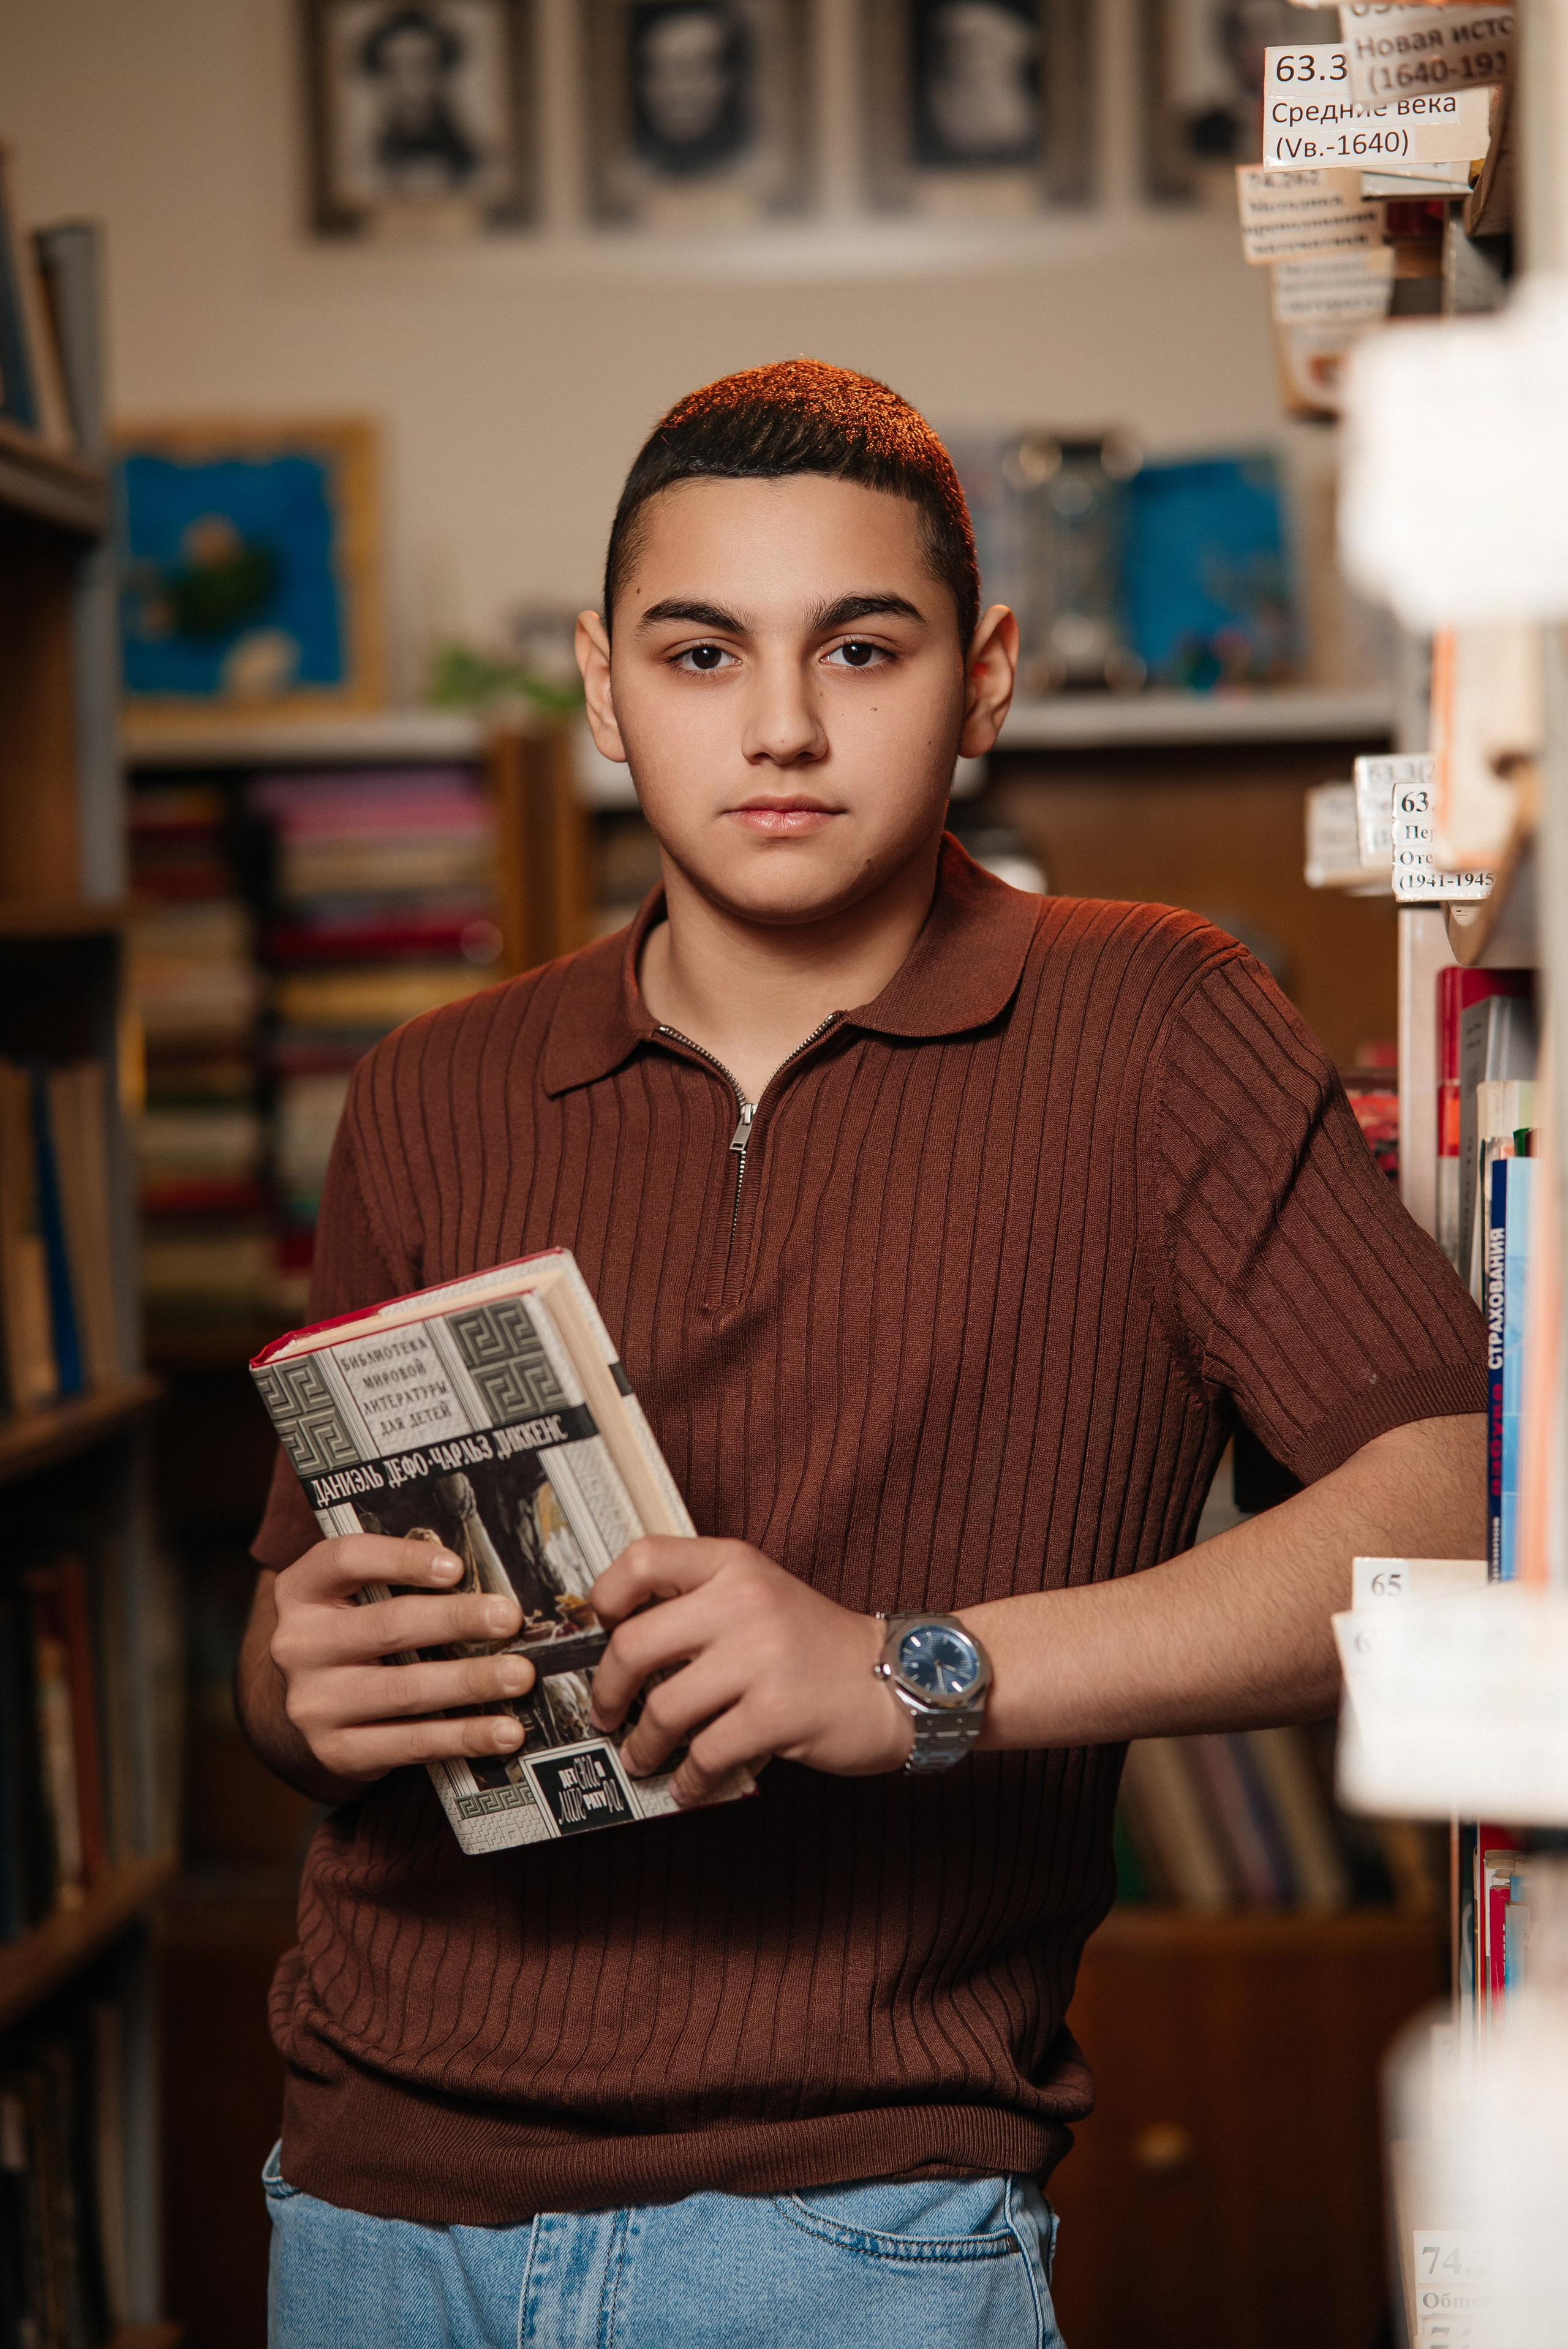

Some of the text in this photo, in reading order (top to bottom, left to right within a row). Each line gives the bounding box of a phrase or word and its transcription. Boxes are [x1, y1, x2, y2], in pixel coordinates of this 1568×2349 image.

[1355, 28, 1444, 60] Новая
[1276, 54, 1348, 81] 63.3
[1397, 95, 1457, 115] века
[1276, 129, 1409, 160] (Vв.-1640)
[1400, 872, 1494, 892] (1941-1945
[1488, 1227, 1505, 1370] СТРАХОВАНИЯ
[341, 1337, 428, 1371] БИБЛИОТЕКА
[363, 1358, 427, 1389] МИРОВОЙ
[363, 1380, 449, 1416] ЛИТЕРАТУРЫ
[380, 1401, 452, 1436] ДЛЯ ДЕТЕЙ
[311, 1465, 385, 1508] ДАНИЭЛЬ
[492, 1414, 568, 1461] ДИККЕНС
[1371, 1572, 1403, 1597] 65
